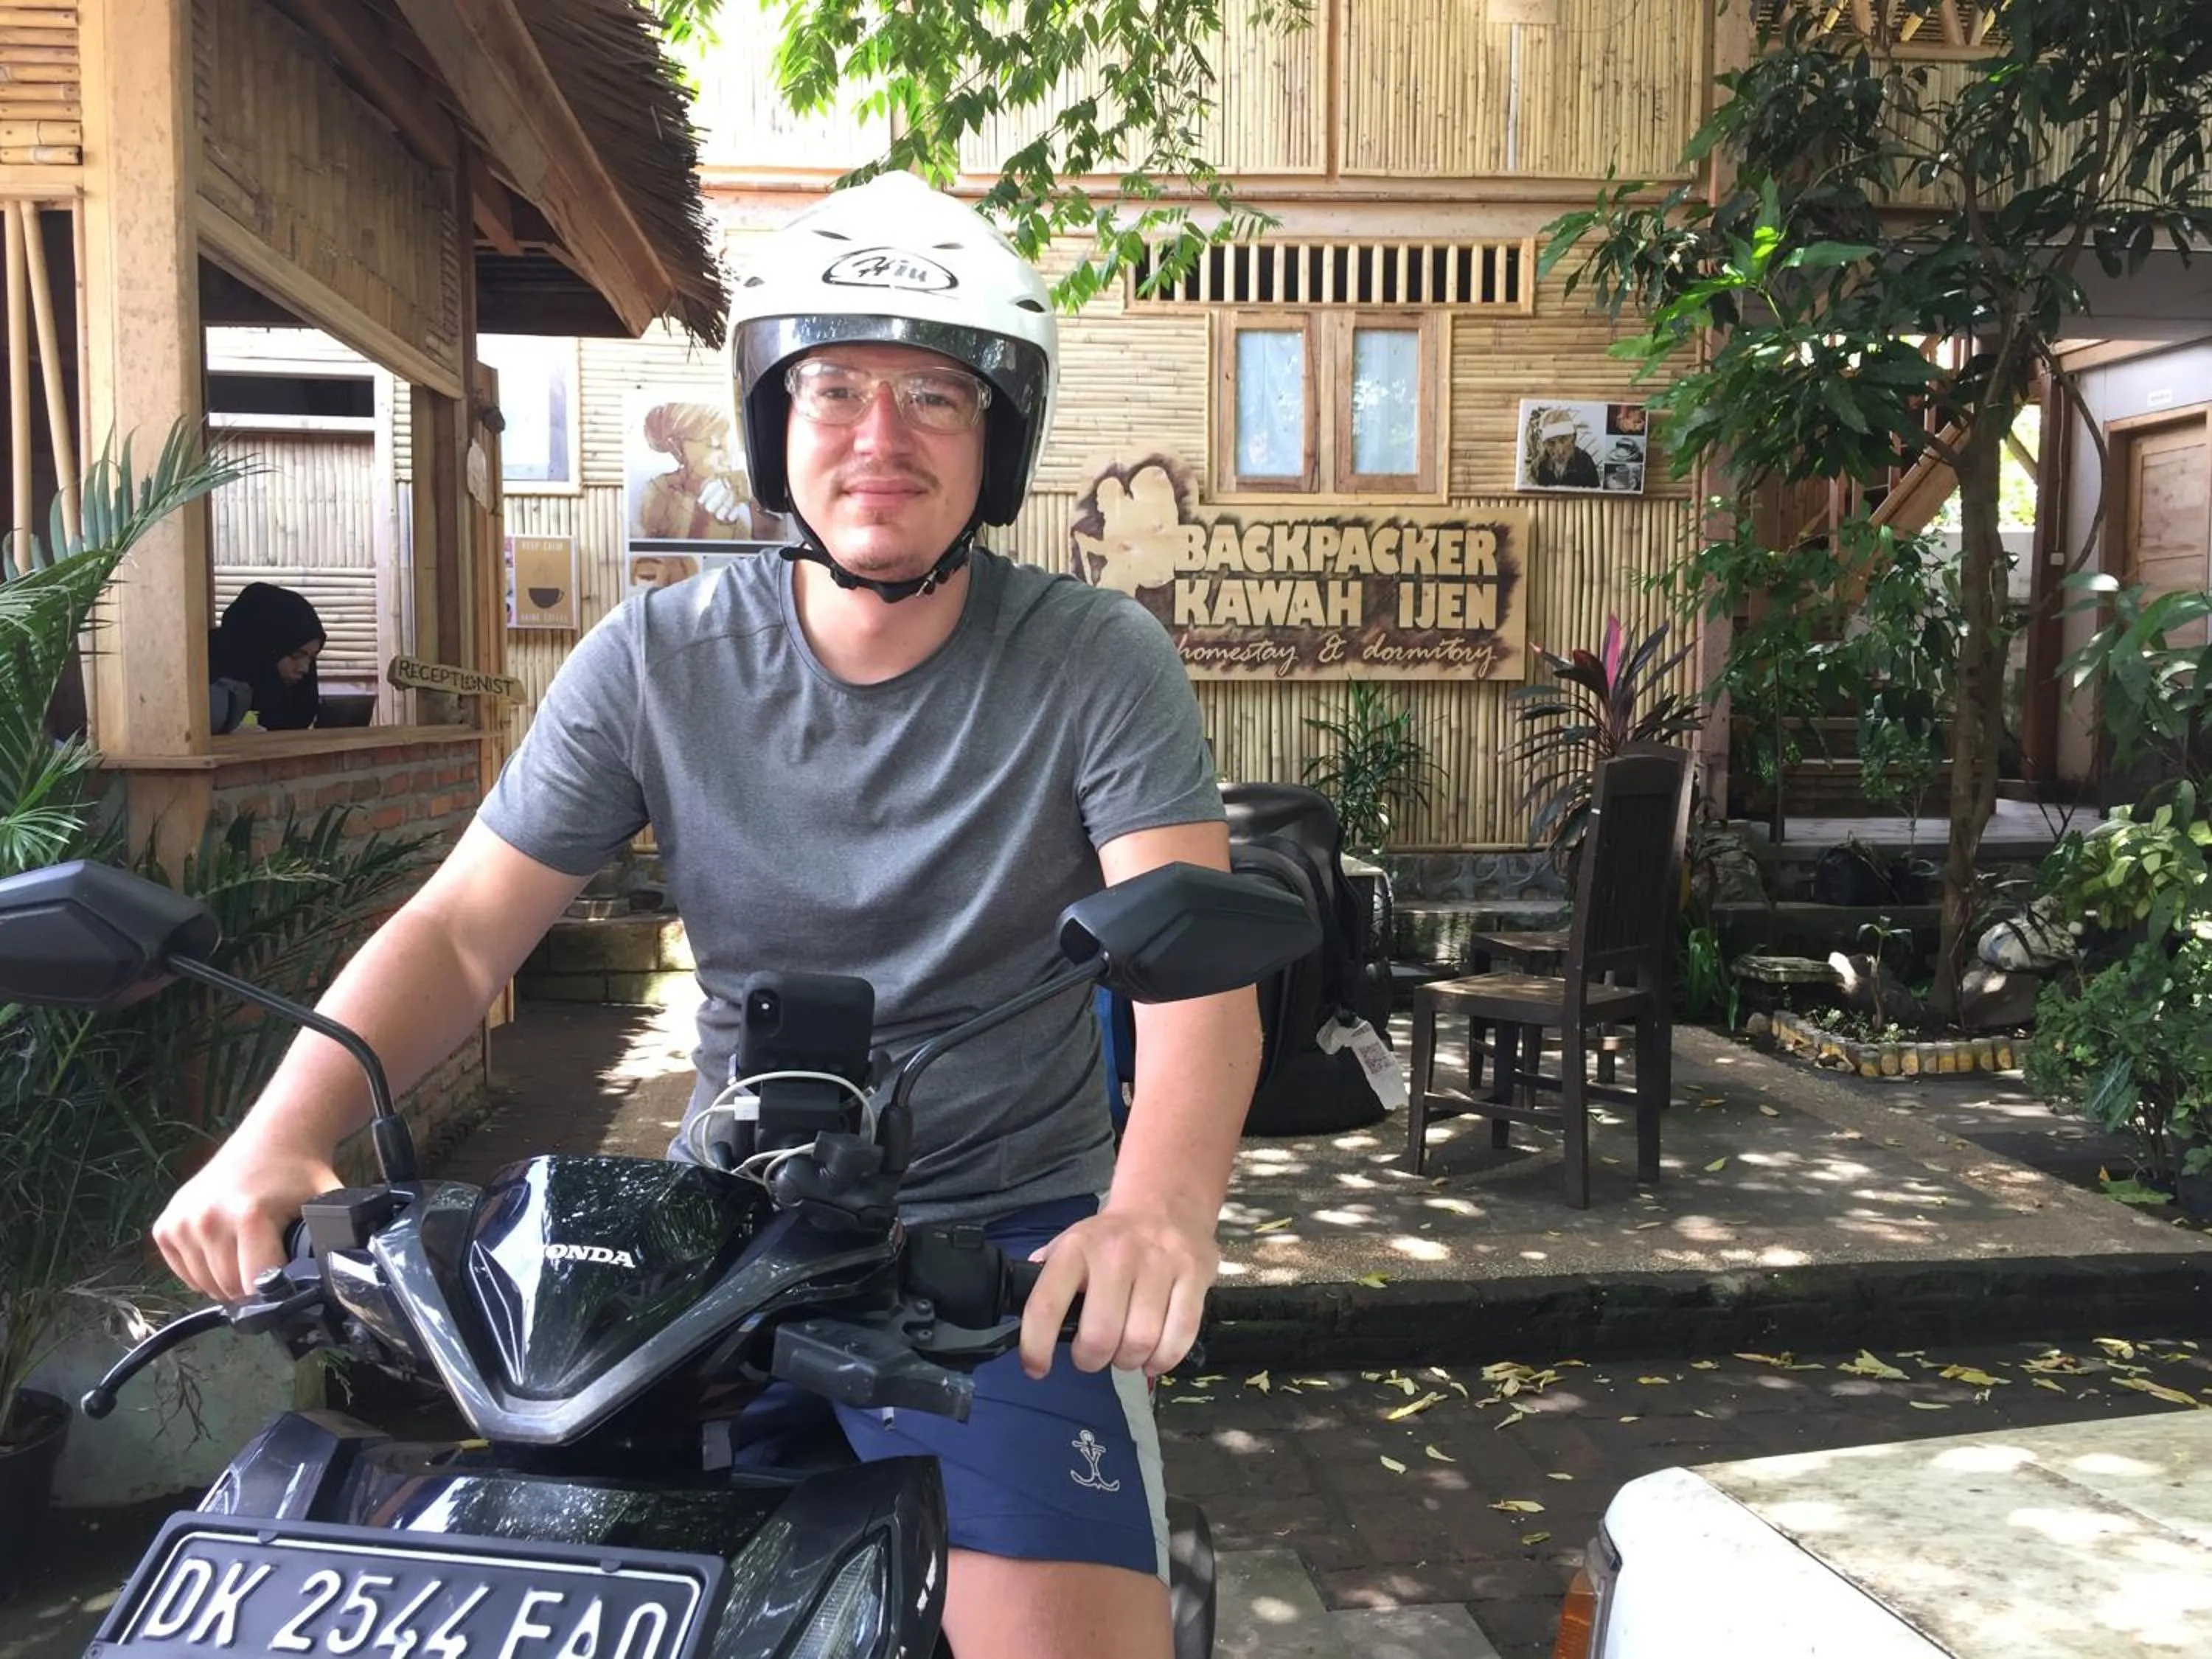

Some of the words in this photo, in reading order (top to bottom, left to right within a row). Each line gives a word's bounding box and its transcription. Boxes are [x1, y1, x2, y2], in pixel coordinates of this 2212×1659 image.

[1175, 524, 1498, 576] BACKPACKER
[1174, 579, 1363, 627] KAWAH
[1399, 581, 1498, 630] IJEN
[398, 660, 515, 697] RECEPTIONIST
[1177, 633, 1298, 678] homestay
[1318, 632, 1347, 663] &
[1363, 633, 1498, 678] dormitory
[543, 1243, 636, 1269] ONDA
[140, 1557, 273, 1647] DK
[268, 1568, 493, 1659] 2544
